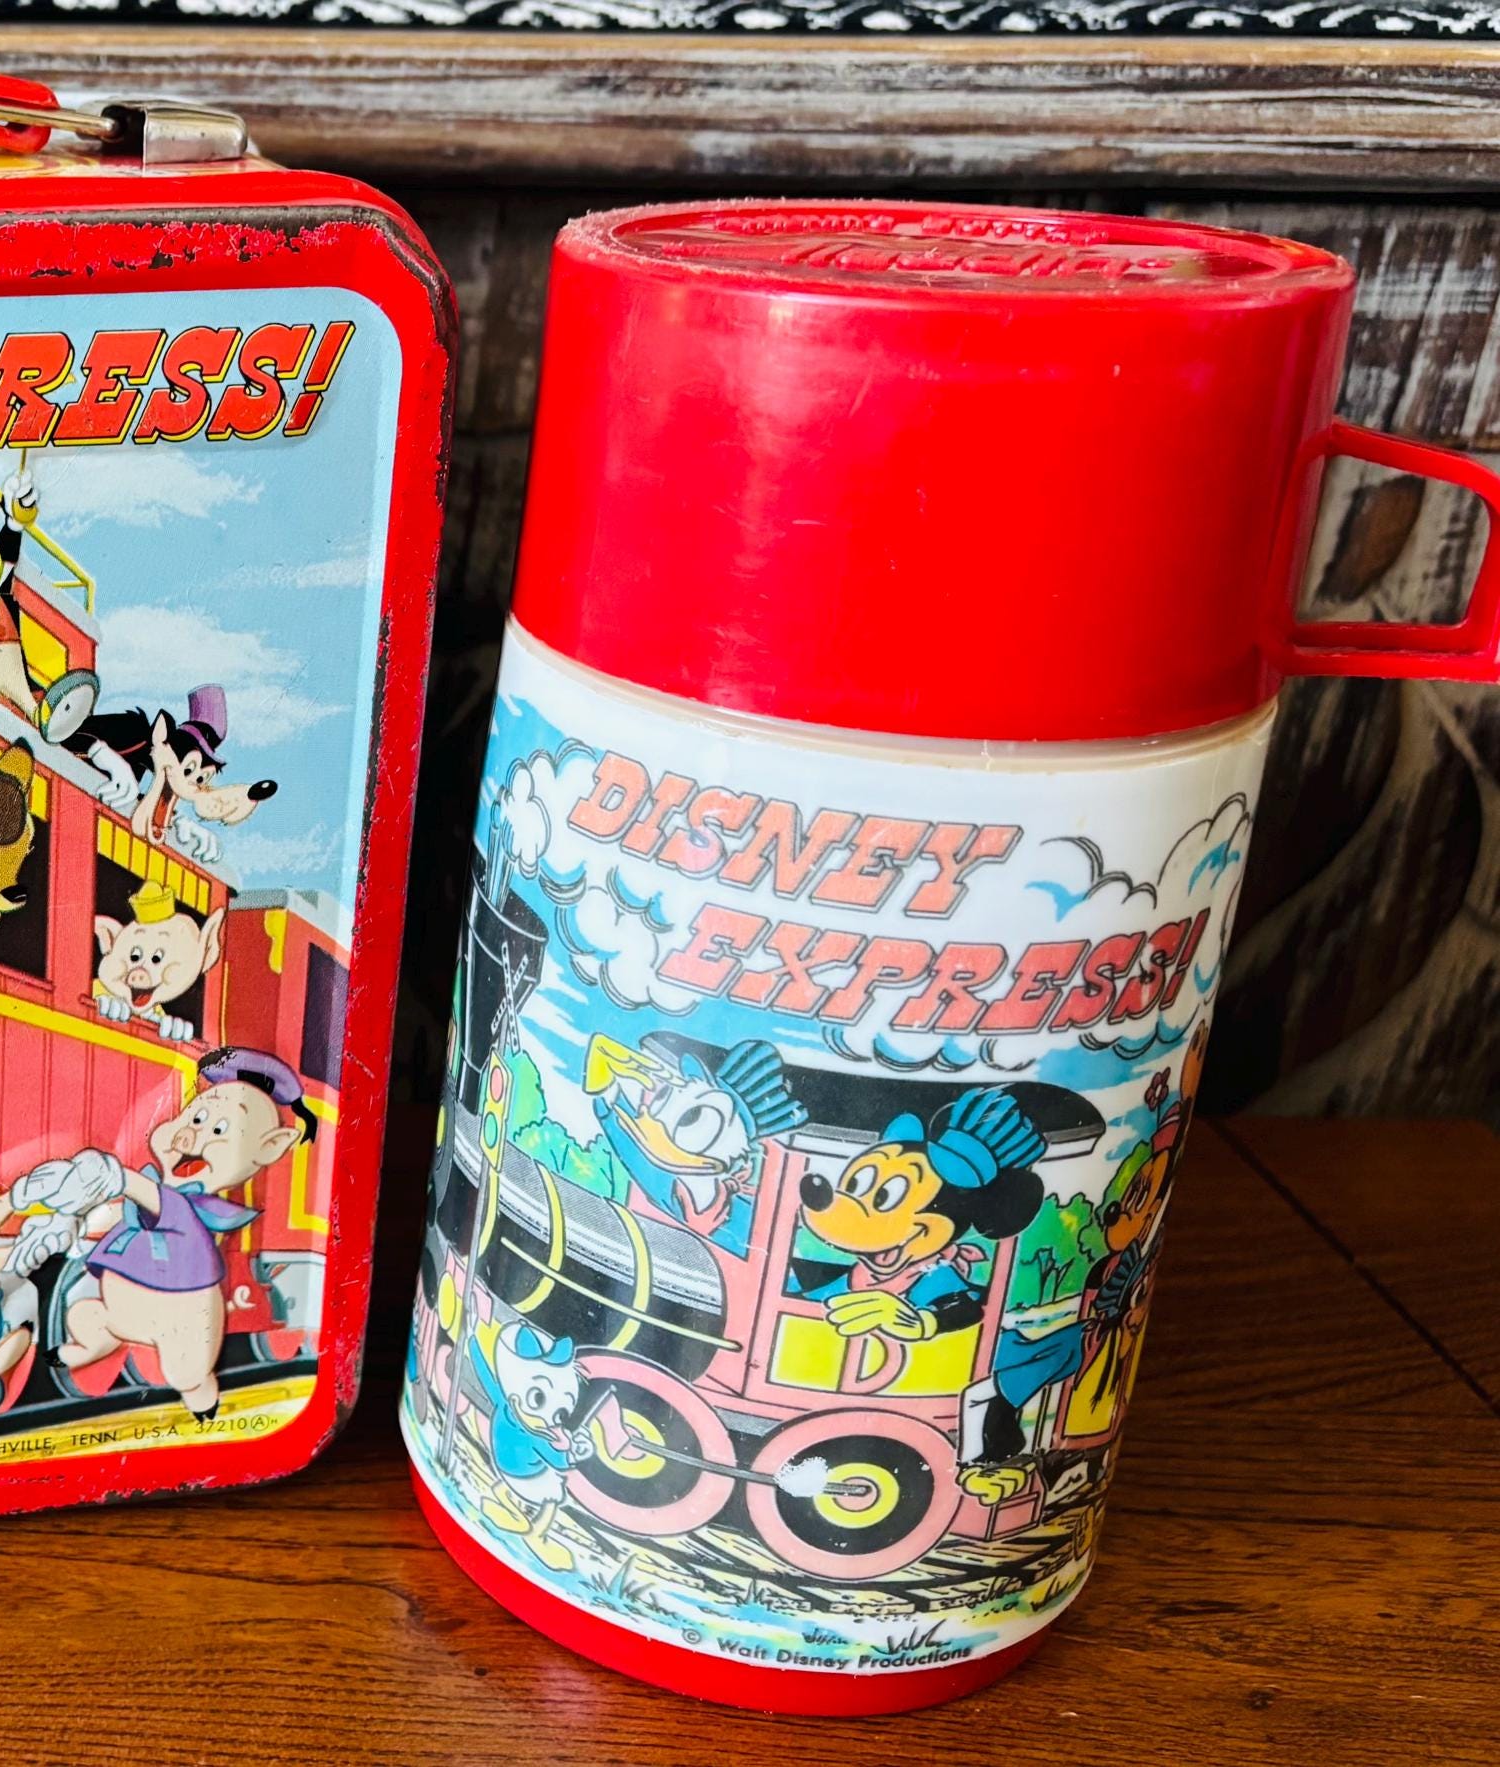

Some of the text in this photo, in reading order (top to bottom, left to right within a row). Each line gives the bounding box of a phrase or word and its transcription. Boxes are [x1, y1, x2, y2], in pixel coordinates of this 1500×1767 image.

[569, 750, 1022, 919] DISNEY
[656, 902, 1210, 1034] EXPRESS!
[195, 1416, 248, 1434] 37210
[717, 1637, 767, 1661] Walt
[775, 1648, 849, 1670] Disney
[858, 1644, 972, 1669] Productions
